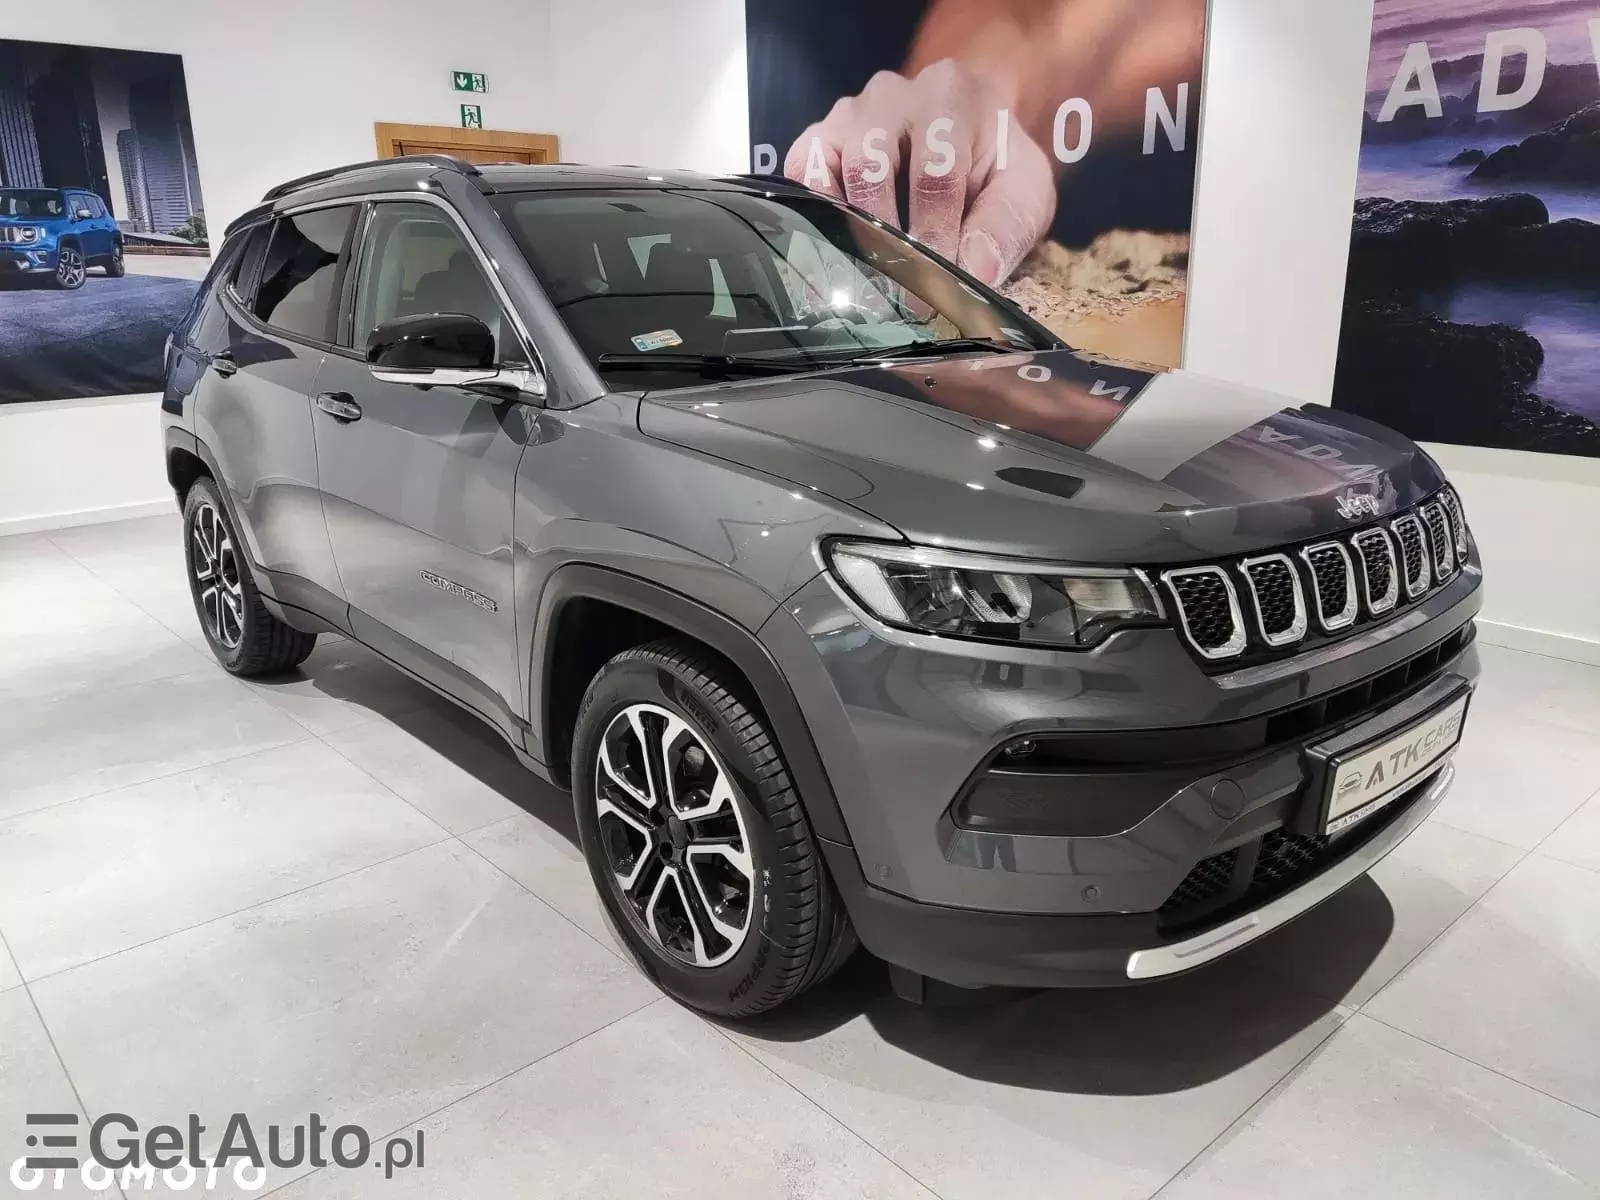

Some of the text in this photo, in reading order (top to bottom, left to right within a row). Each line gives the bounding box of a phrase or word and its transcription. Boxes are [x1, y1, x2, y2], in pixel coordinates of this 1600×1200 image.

[1376, 17, 1600, 123] AD
[754, 82, 1189, 188] PASSION
[1336, 494, 1379, 518] Jeep
[419, 569, 498, 614] COMPASS
[1365, 738, 1423, 790] ATK
